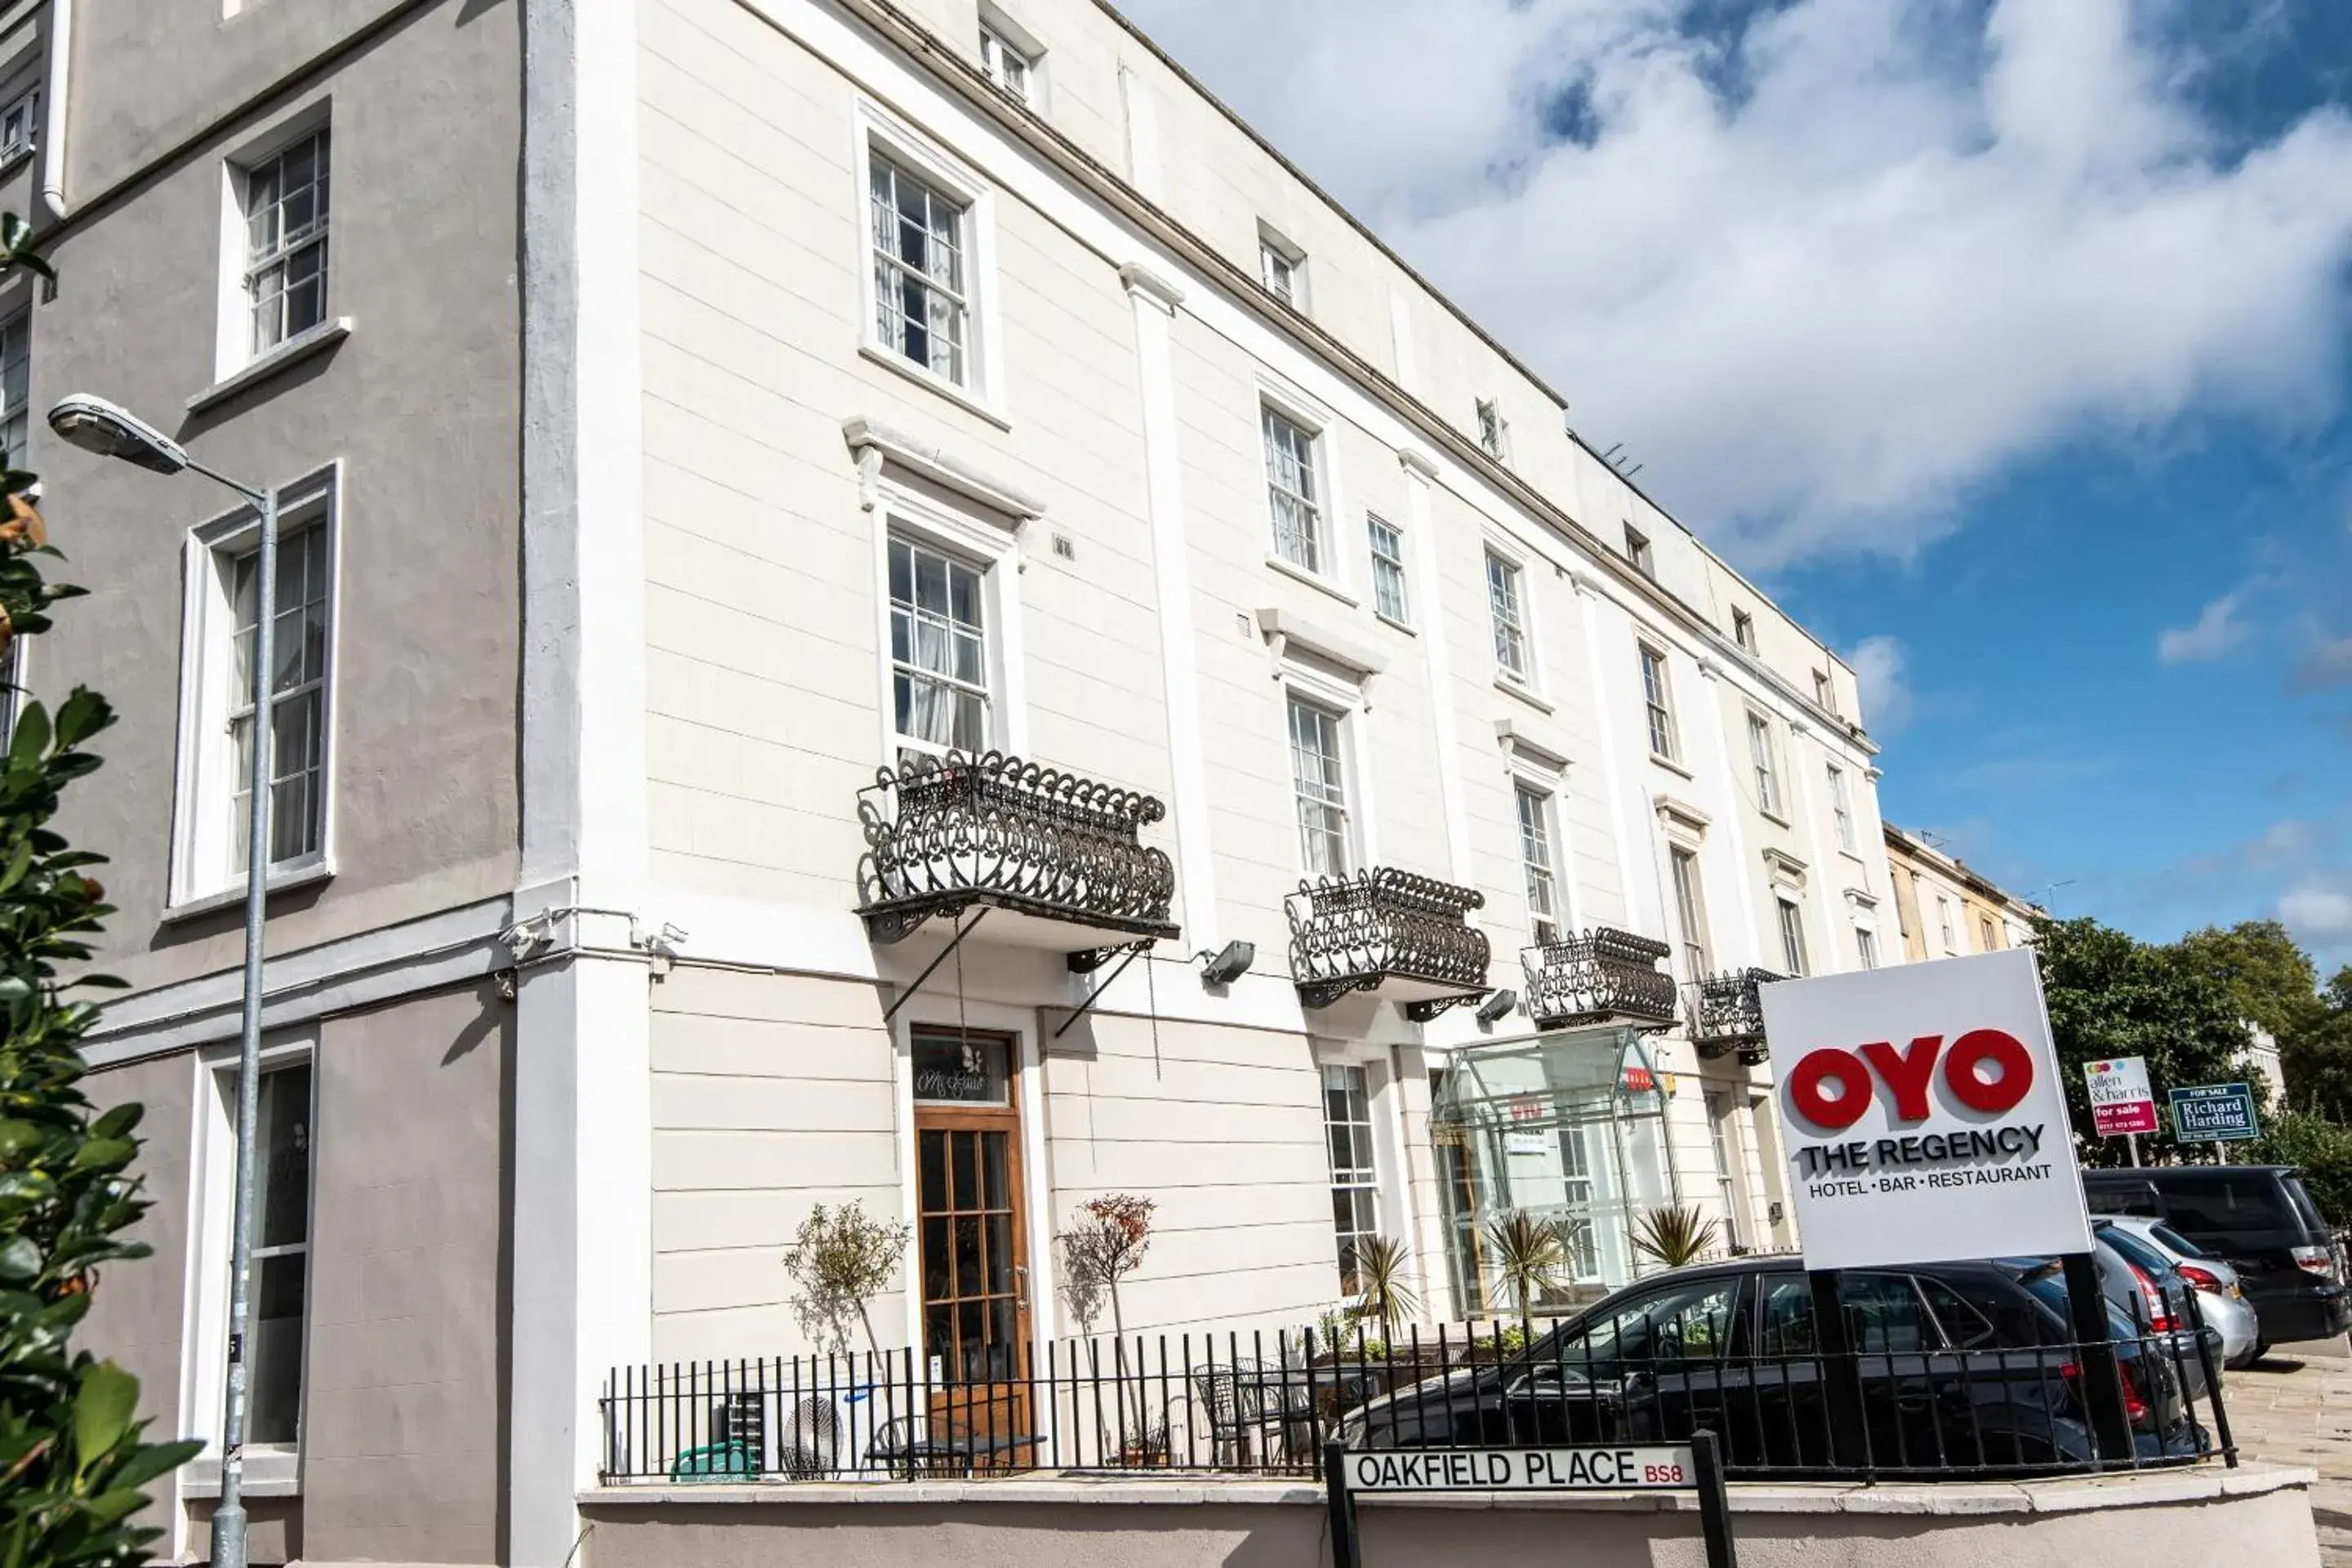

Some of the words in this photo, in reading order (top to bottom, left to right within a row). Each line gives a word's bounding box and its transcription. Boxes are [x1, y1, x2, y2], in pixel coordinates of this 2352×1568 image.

[1791, 1029, 2034, 1129] OYO
[2090, 1075, 2122, 1088] allen
[2189, 1089, 2207, 1098] FOR
[2207, 1088, 2229, 1096] SALE
[2096, 1107, 2114, 1117] for
[2116, 1103, 2140, 1116] sale
[2183, 1098, 2243, 1116] Richard
[2185, 1112, 2246, 1127] Harding
[1802, 1141, 1870, 1172] THE
[1878, 1124, 2044, 1167] REGENCY
[1810, 1180, 1869, 1199] HOTEL
[1881, 1175, 1916, 1193] BAR
[1929, 1164, 2052, 1188] RESTAURANT
[1357, 1454, 1511, 1486] OAKFIELD
[1526, 1451, 1638, 1485] PLACE
[1644, 1465, 1684, 1483] BS8
